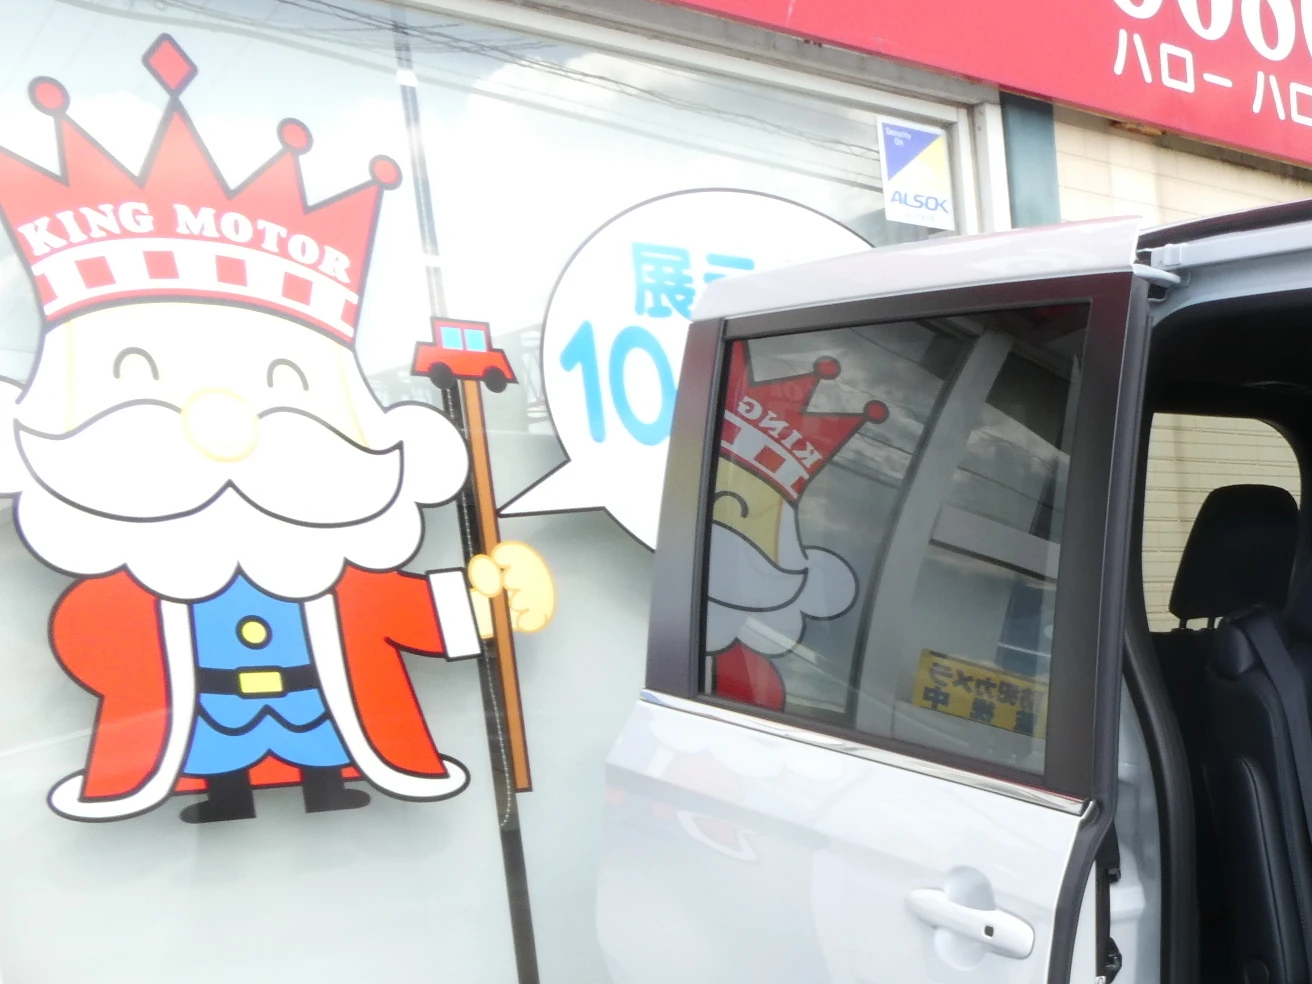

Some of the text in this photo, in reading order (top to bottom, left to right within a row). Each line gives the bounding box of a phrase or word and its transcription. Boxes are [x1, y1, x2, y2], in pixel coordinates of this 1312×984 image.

[1113, 28, 1232, 93] ハロー
[891, 191, 949, 213] ALSOK
[17, 201, 351, 284] KING MOTOR
